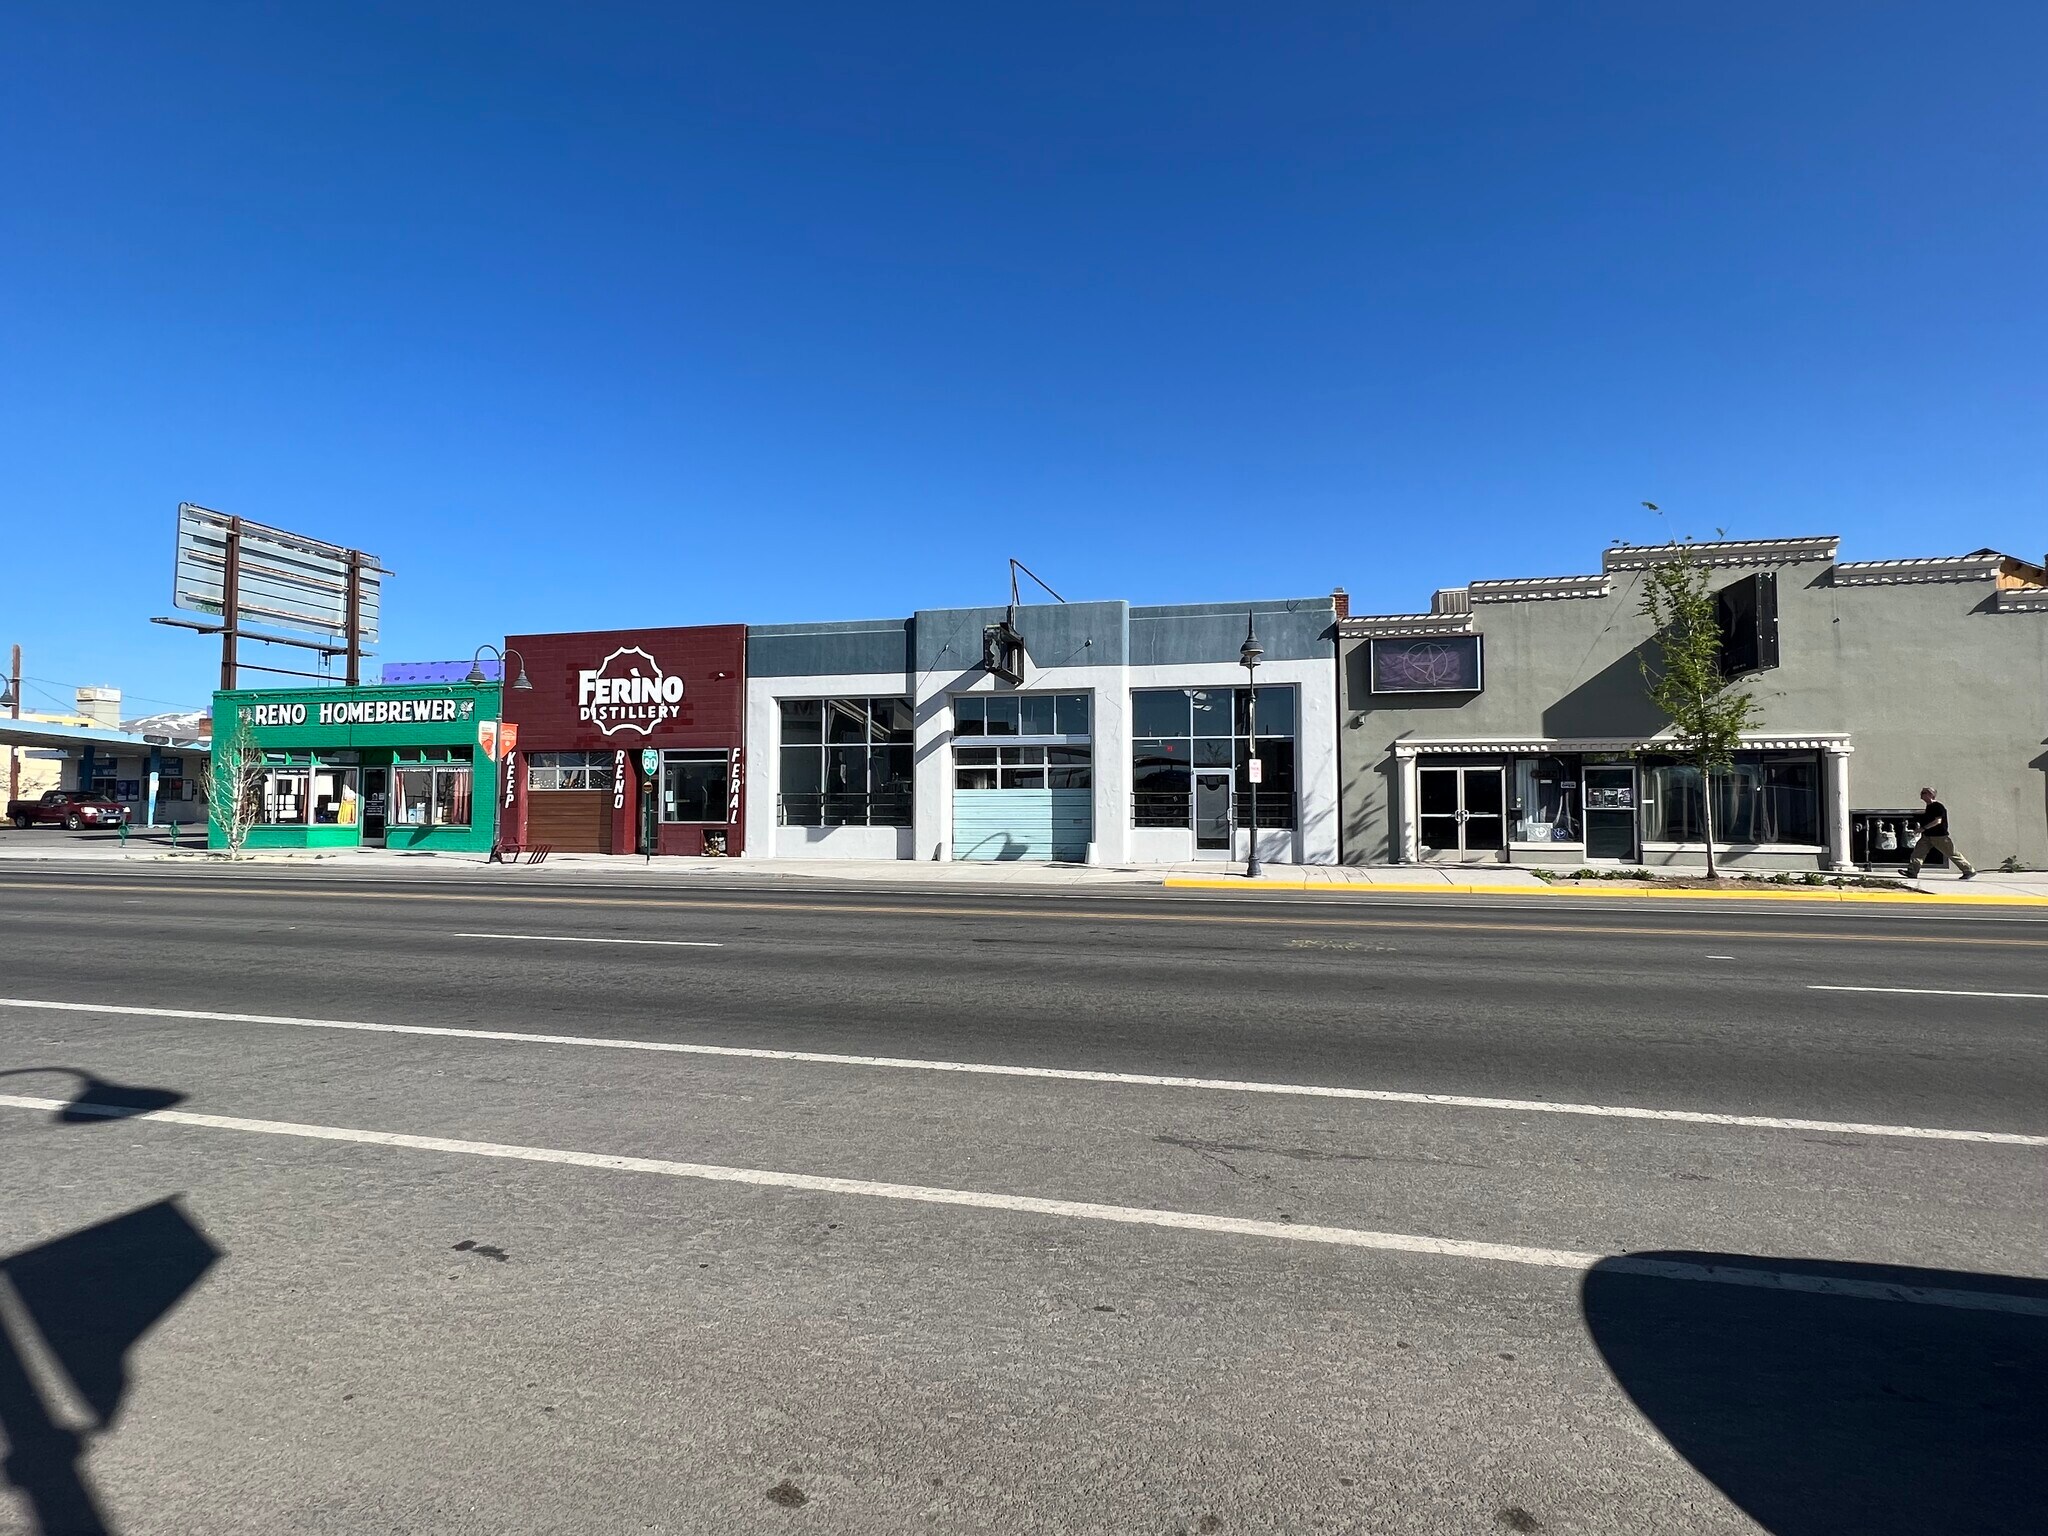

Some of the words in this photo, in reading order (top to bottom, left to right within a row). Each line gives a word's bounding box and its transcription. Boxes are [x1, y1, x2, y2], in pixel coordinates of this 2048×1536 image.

[255, 703, 306, 726] RENO
[319, 699, 457, 724] HOMEBREWER
[580, 705, 680, 721] DISTILLERY
[645, 757, 656, 769] 80
[504, 751, 517, 809] KEEP
[613, 749, 626, 809] RENO
[729, 747, 741, 824] FERAL
